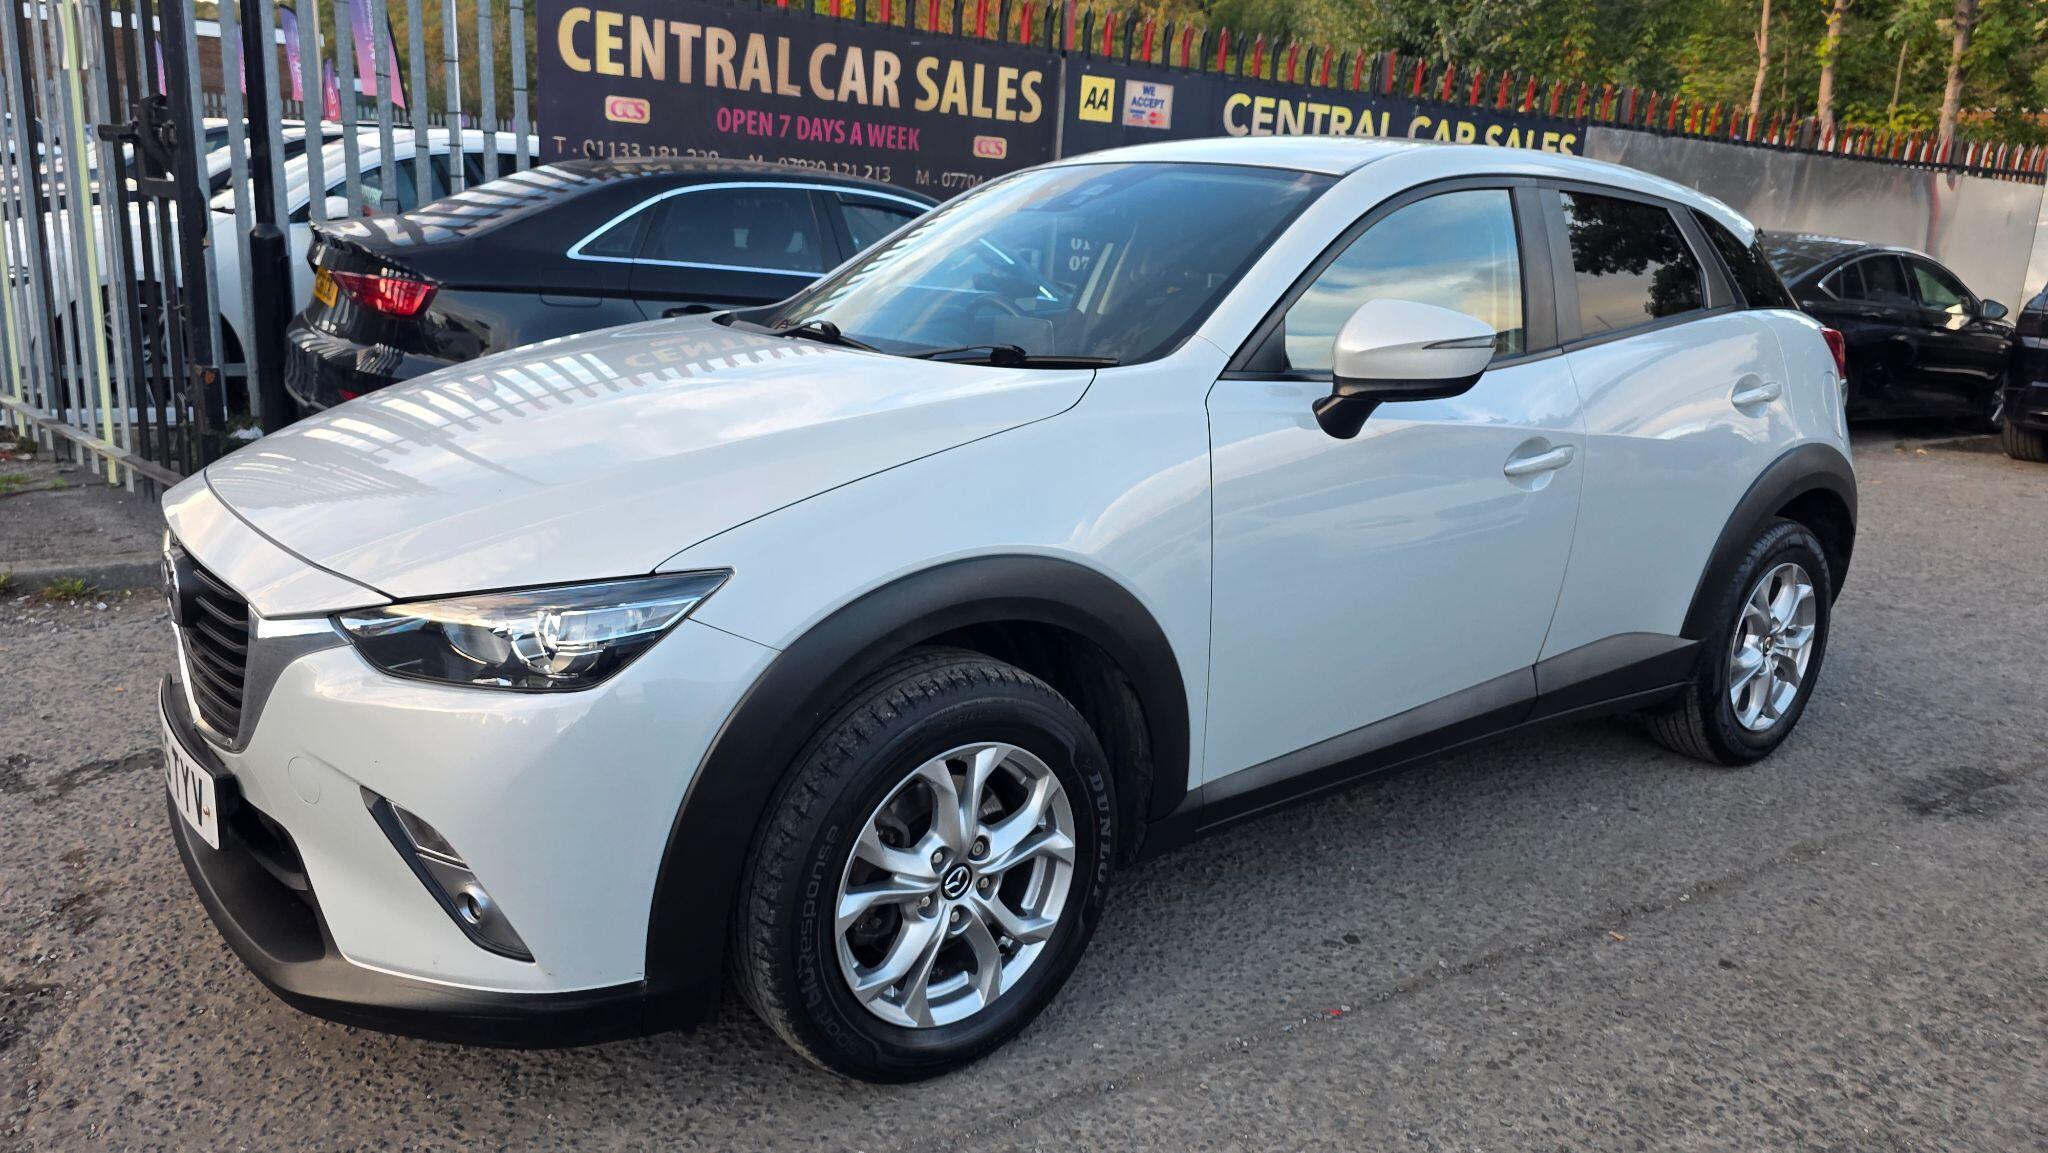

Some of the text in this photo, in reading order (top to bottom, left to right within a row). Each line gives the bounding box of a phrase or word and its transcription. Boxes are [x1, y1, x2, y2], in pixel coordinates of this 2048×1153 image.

[557, 7, 1043, 123] CENTRAL CAR SALES
[1084, 86, 1109, 111] AA
[1131, 97, 1165, 109] ACCEPT
[1143, 85, 1156, 96] WE
[716, 106, 920, 151] OPEN 7 DAYS A WEEK
[1485, 124, 1577, 156] SALES
[863, 165, 892, 183] 213
